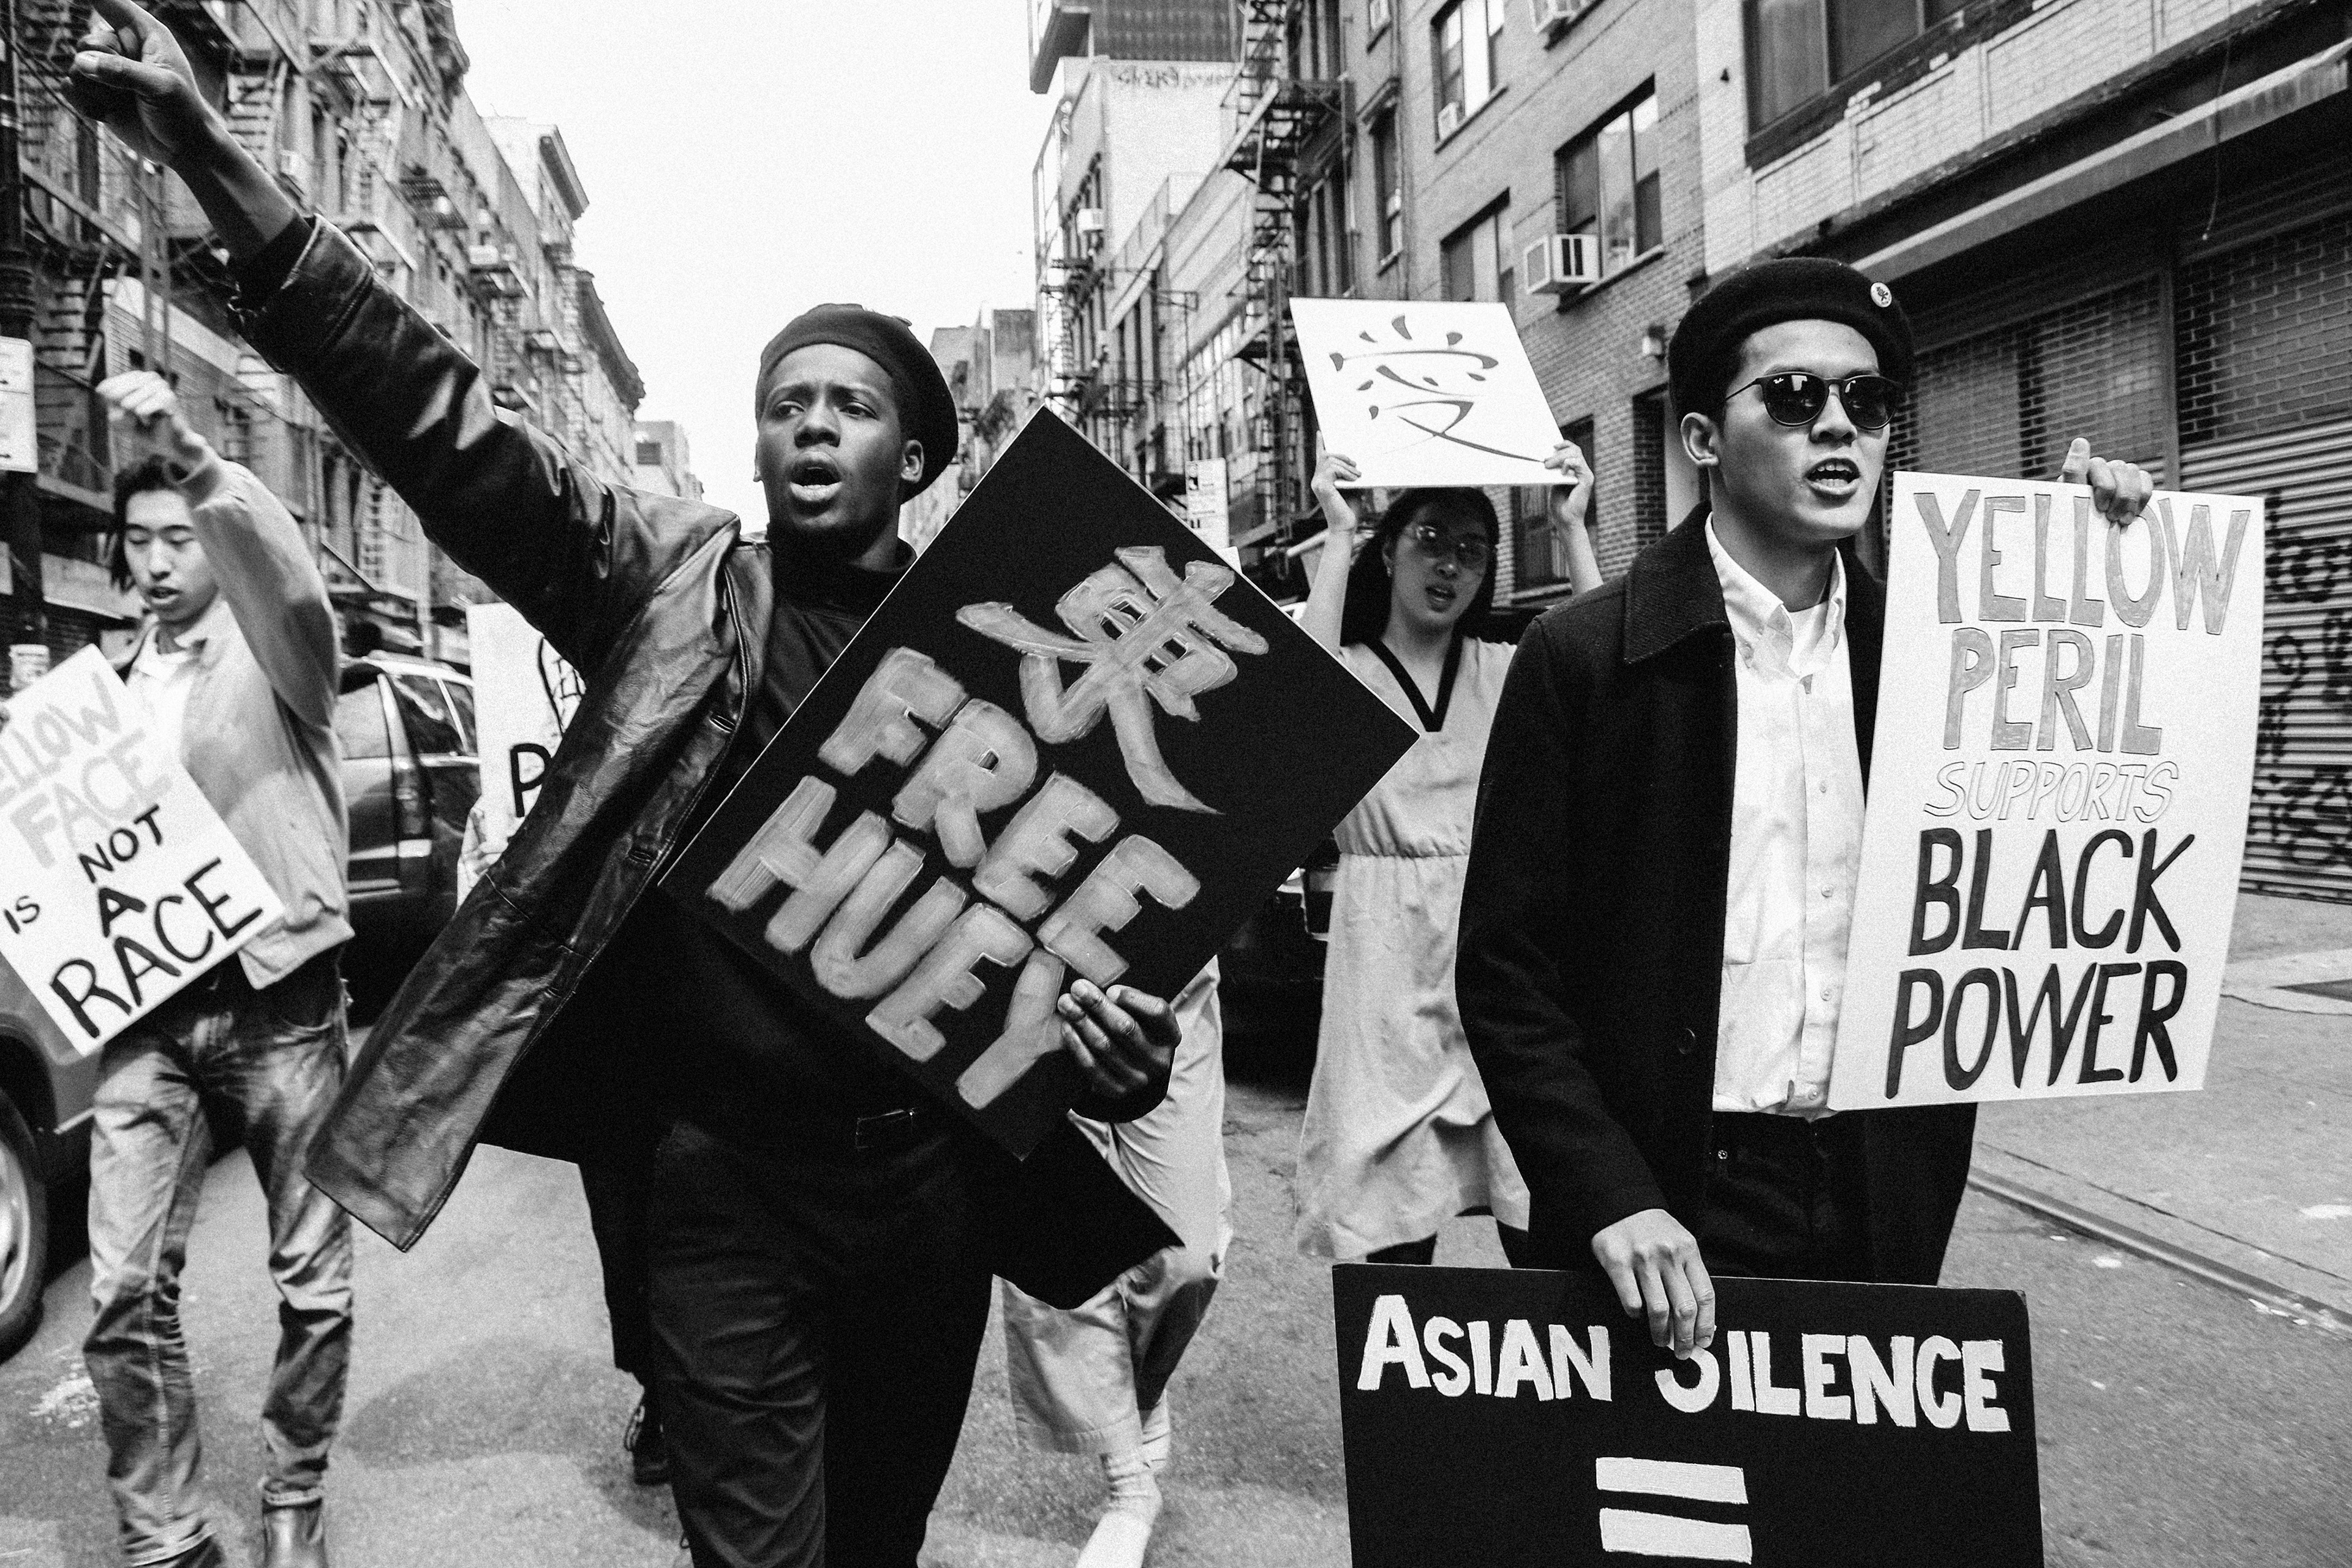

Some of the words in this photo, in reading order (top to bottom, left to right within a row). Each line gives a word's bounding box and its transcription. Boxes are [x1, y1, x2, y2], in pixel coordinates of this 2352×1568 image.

[1329, 314, 1545, 462] 愛
[1913, 489, 2251, 635] YELLOW
[1943, 627, 2163, 756] PERIL
[9, 726, 174, 869] FACE
[817, 646, 1202, 984] FREE
[1923, 760, 2179, 823] SUPPORTS
[4, 895, 40, 934] IS
[78, 804, 164, 884] NOT
[97, 888, 146, 938] A
[1907, 827, 2195, 956] BLACK
[50, 858, 263, 1039] RACE
[705, 775, 1069, 1110] HUEY
[1885, 960, 2188, 1099] POWER
[1357, 1294, 1612, 1401] ASIAN
